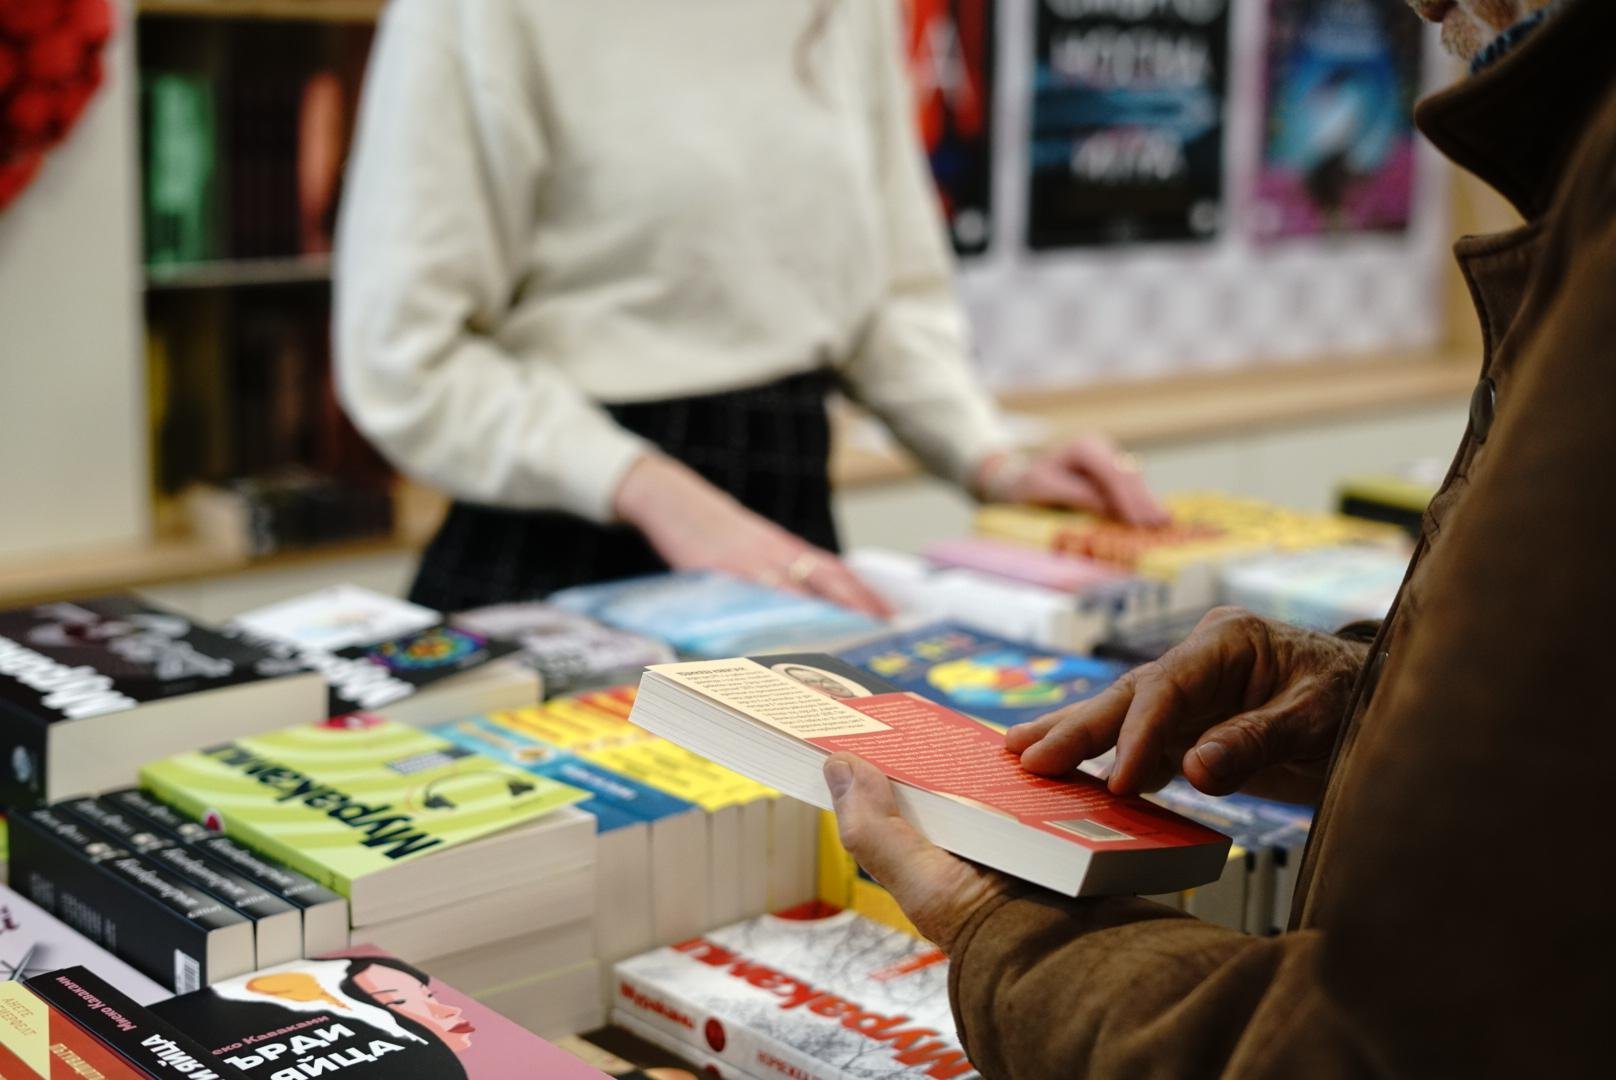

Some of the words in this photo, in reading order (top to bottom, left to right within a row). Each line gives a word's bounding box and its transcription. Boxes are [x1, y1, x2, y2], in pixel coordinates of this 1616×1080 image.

[199, 741, 446, 860] Мураками
[56, 975, 106, 1010] Каваками
[668, 937, 975, 1080] Мураками
[100, 1007, 137, 1032] Миеко
[211, 1042, 243, 1056] еко
[242, 1015, 331, 1045] Каваками
[140, 1033, 206, 1072] ЯЙЦА
[223, 1022, 357, 1071] ЪРДИ
[269, 1039, 406, 1080] ЯЙЦА
